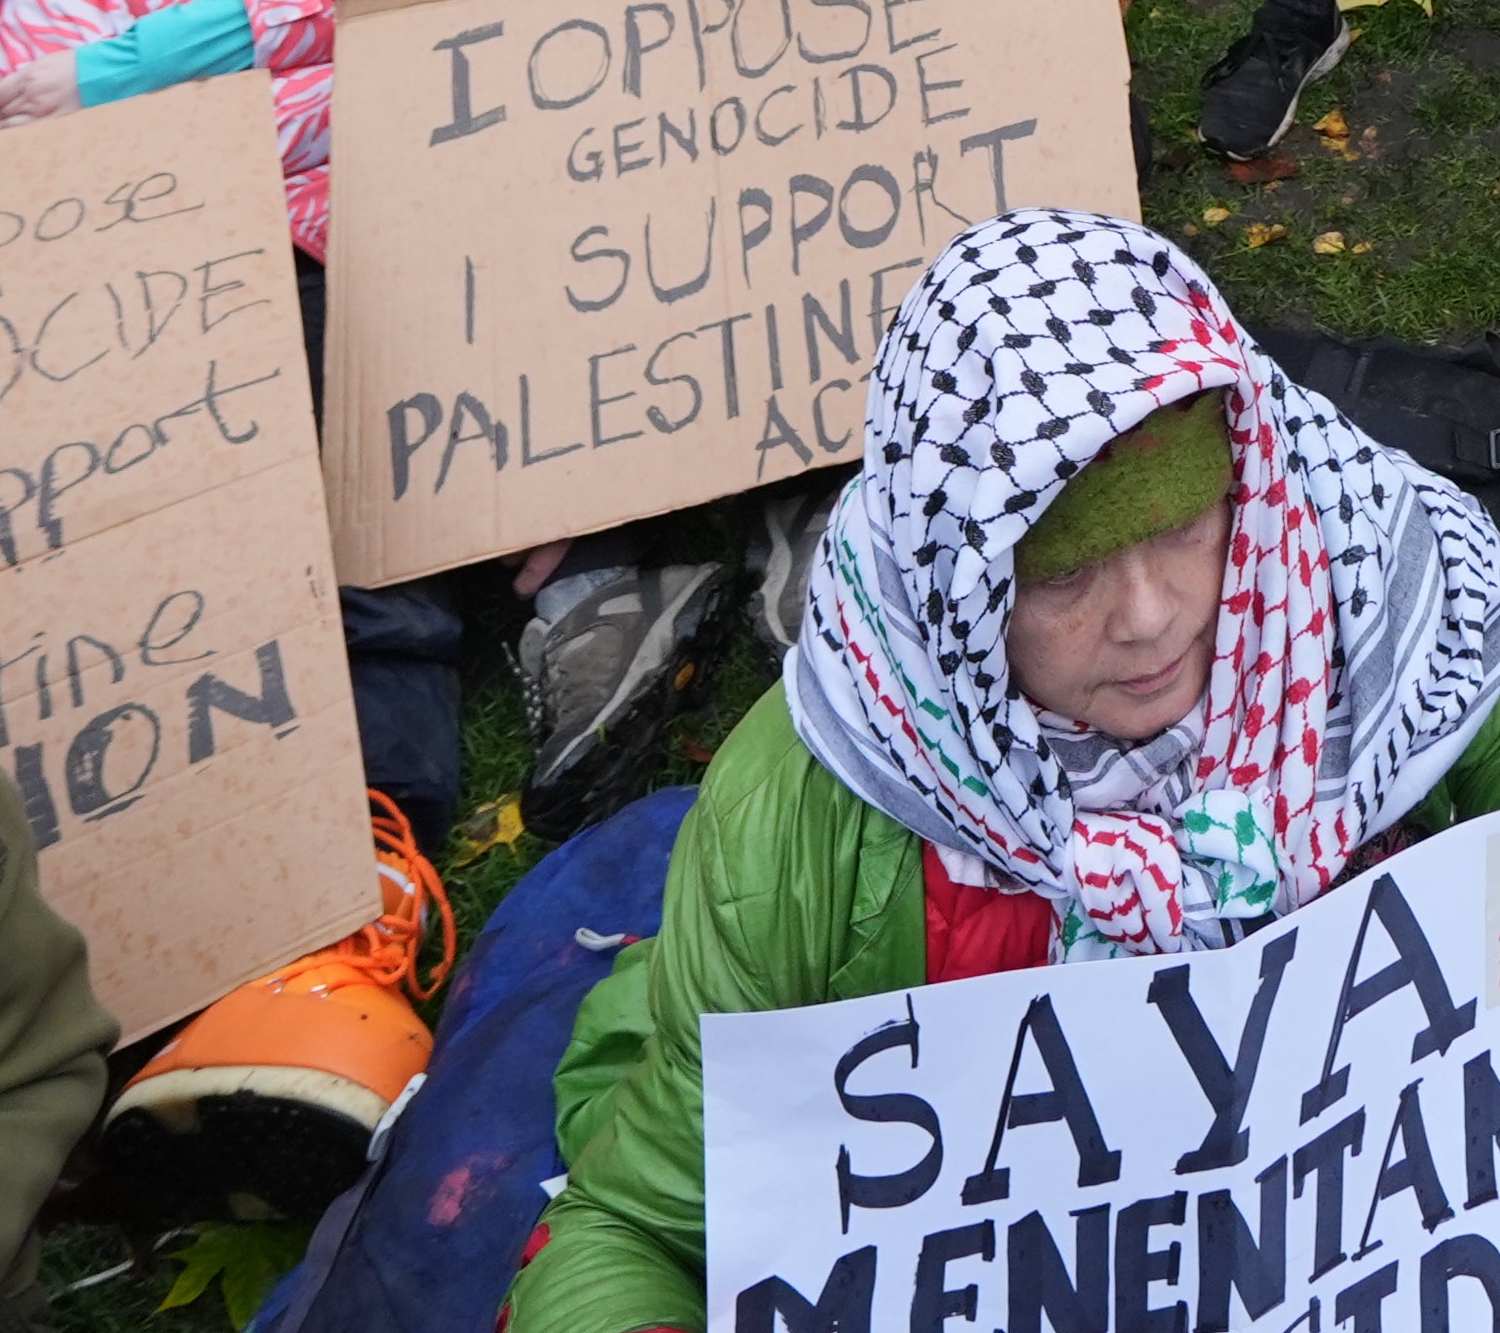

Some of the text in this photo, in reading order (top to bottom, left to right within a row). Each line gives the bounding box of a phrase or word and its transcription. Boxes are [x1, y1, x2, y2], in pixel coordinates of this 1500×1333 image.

[428, 21, 506, 149] I
[566, 42, 973, 184] GENOCIDE
[463, 118, 1039, 345] I SUPPORT
[833, 873, 1479, 1235] SAYA
